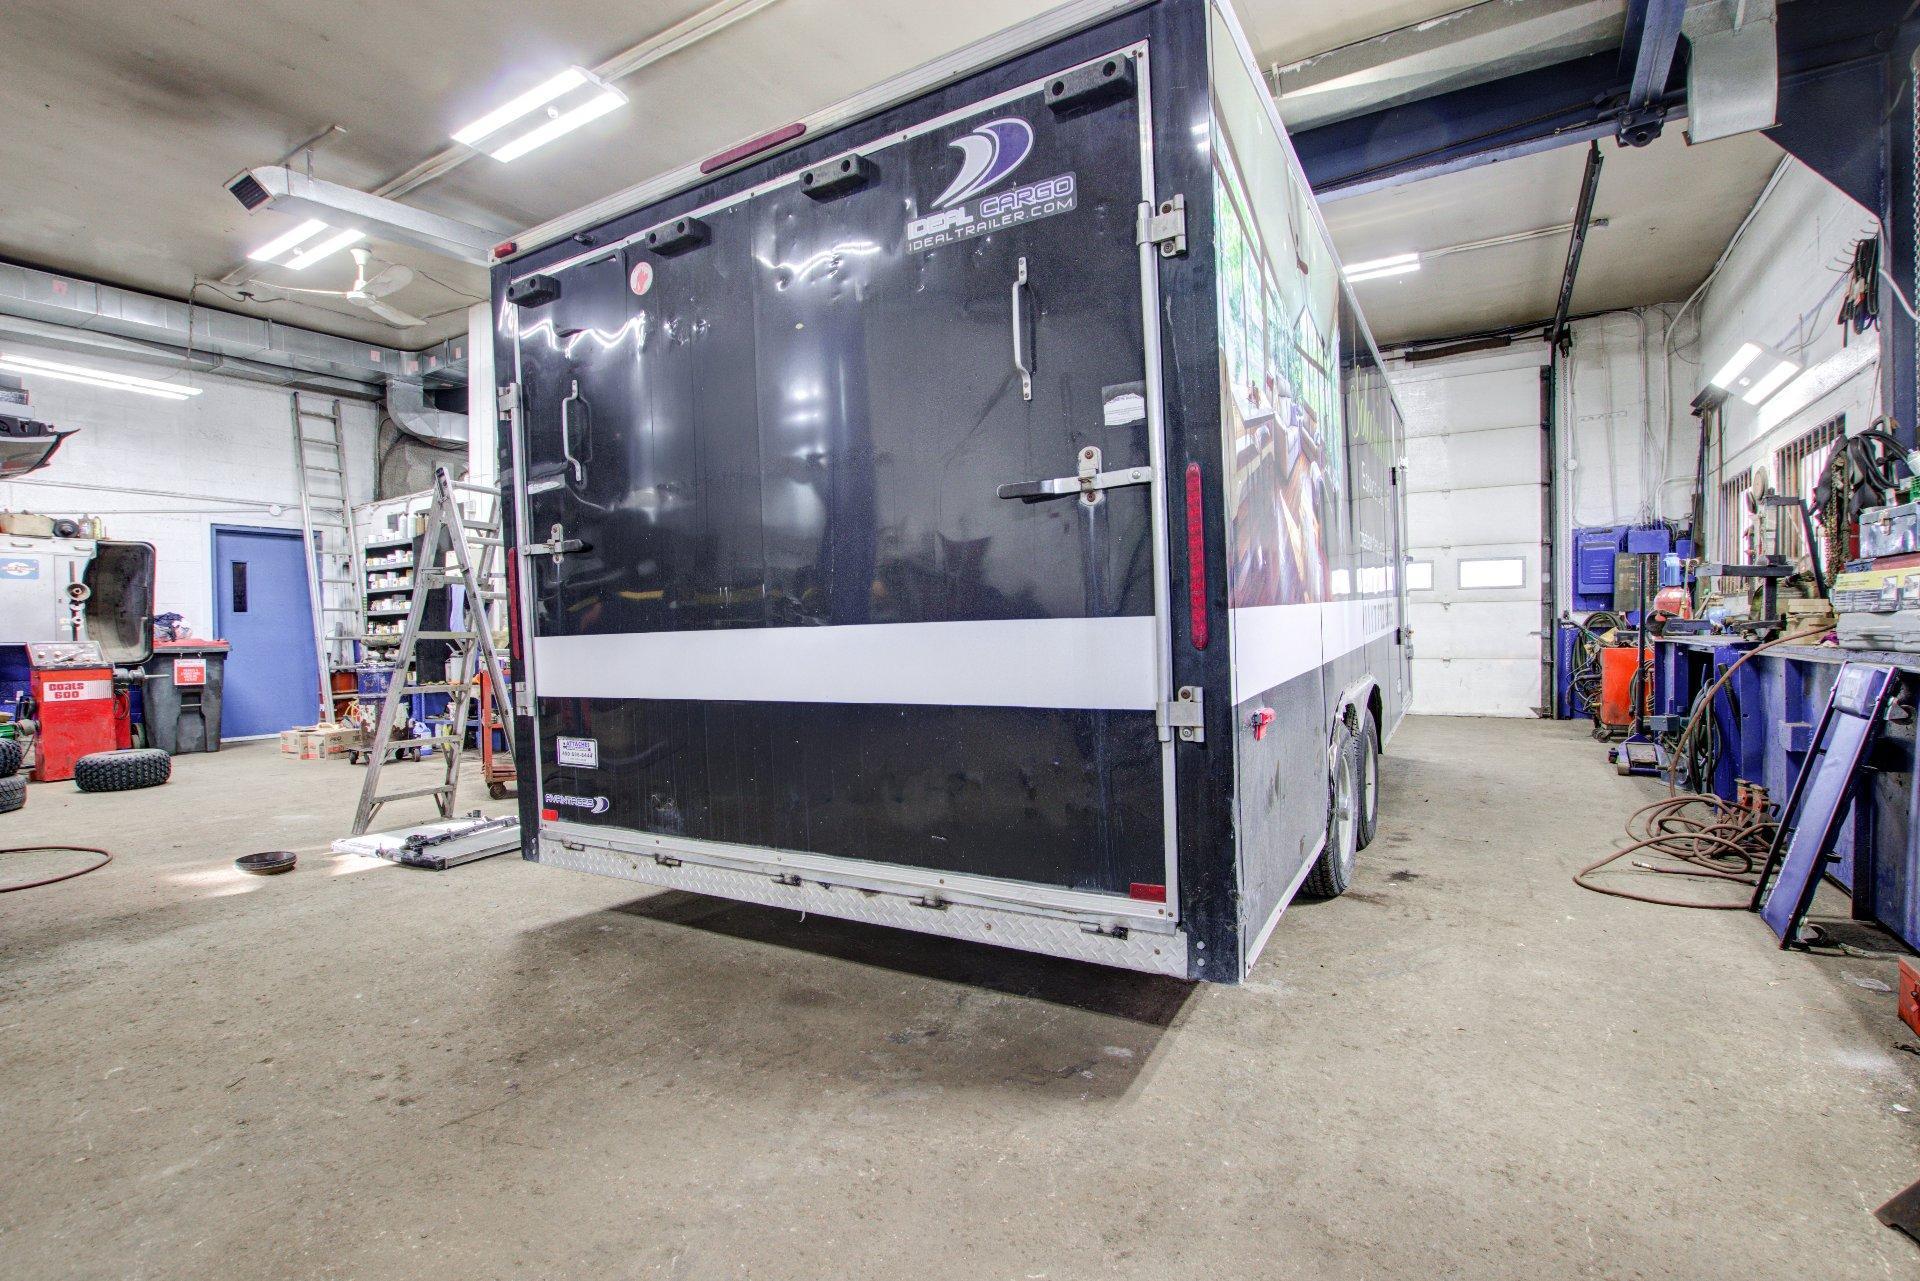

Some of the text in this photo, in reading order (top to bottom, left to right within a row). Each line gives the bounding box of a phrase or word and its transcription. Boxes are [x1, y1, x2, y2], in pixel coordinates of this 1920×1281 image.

[907, 174, 1074, 241] IDEAL CARGO
[908, 197, 1074, 253] IDEALTRAILER.COM
[54, 691, 80, 699] 600
